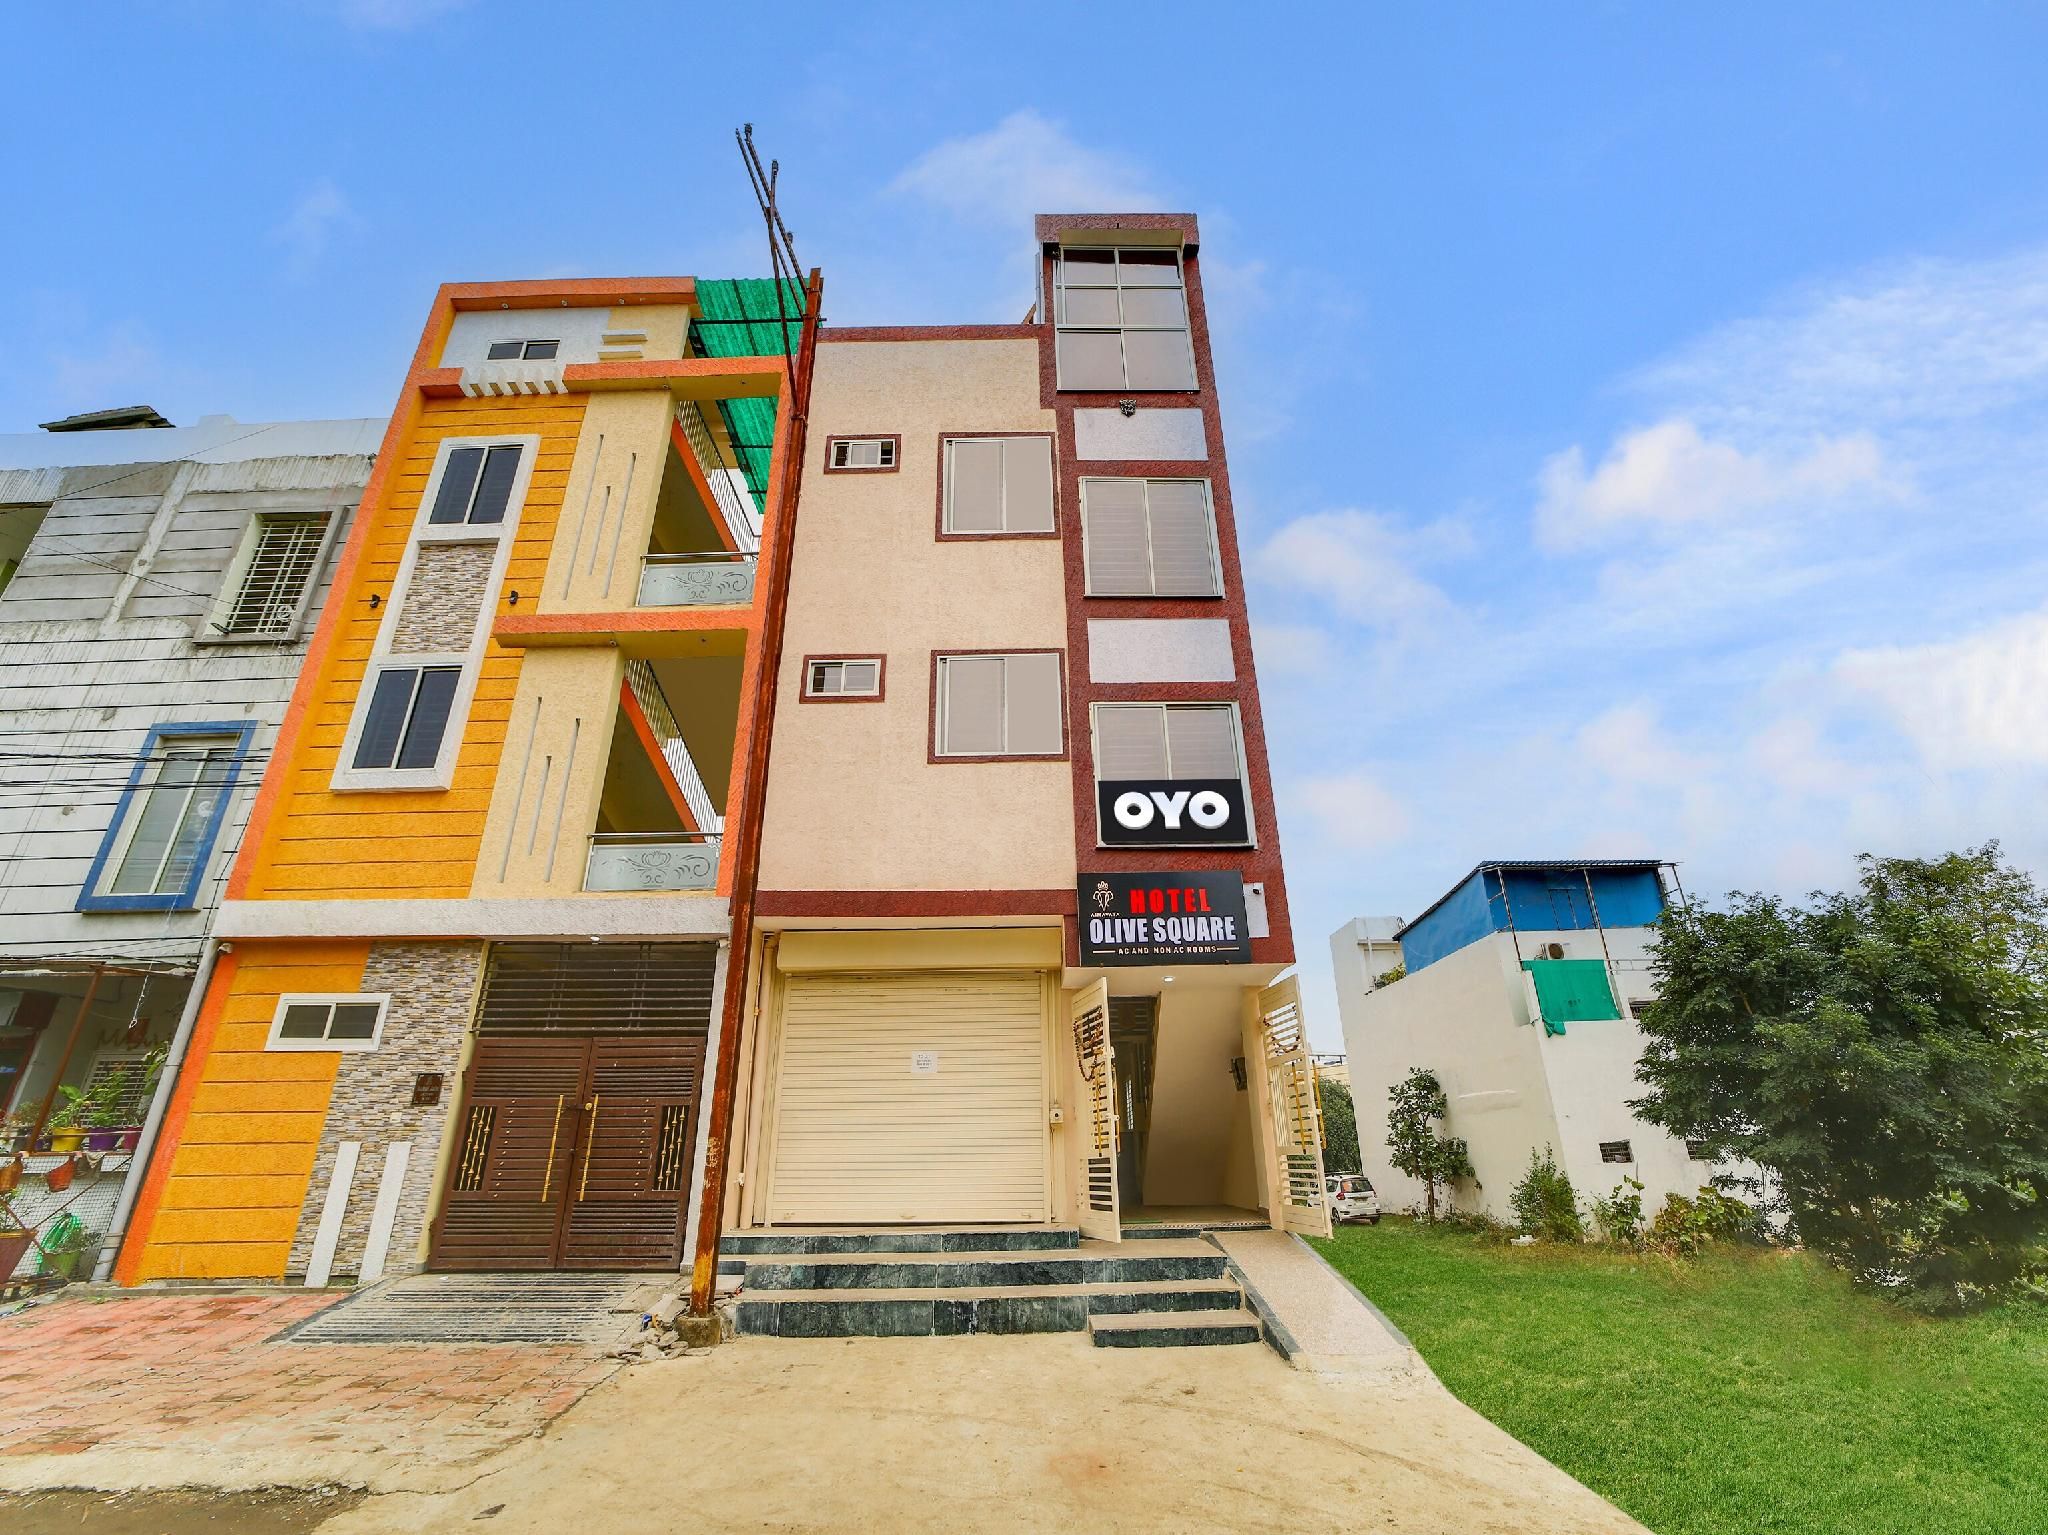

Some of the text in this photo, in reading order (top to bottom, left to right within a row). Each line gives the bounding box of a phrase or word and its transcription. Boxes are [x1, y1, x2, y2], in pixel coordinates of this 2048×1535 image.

[1114, 790, 1230, 830] OYO
[1129, 888, 1212, 914] HOTEL
[1089, 916, 1237, 945] OLIVE SQUARE
[1118, 945, 1217, 955] AC AND NON AC ROOMS
